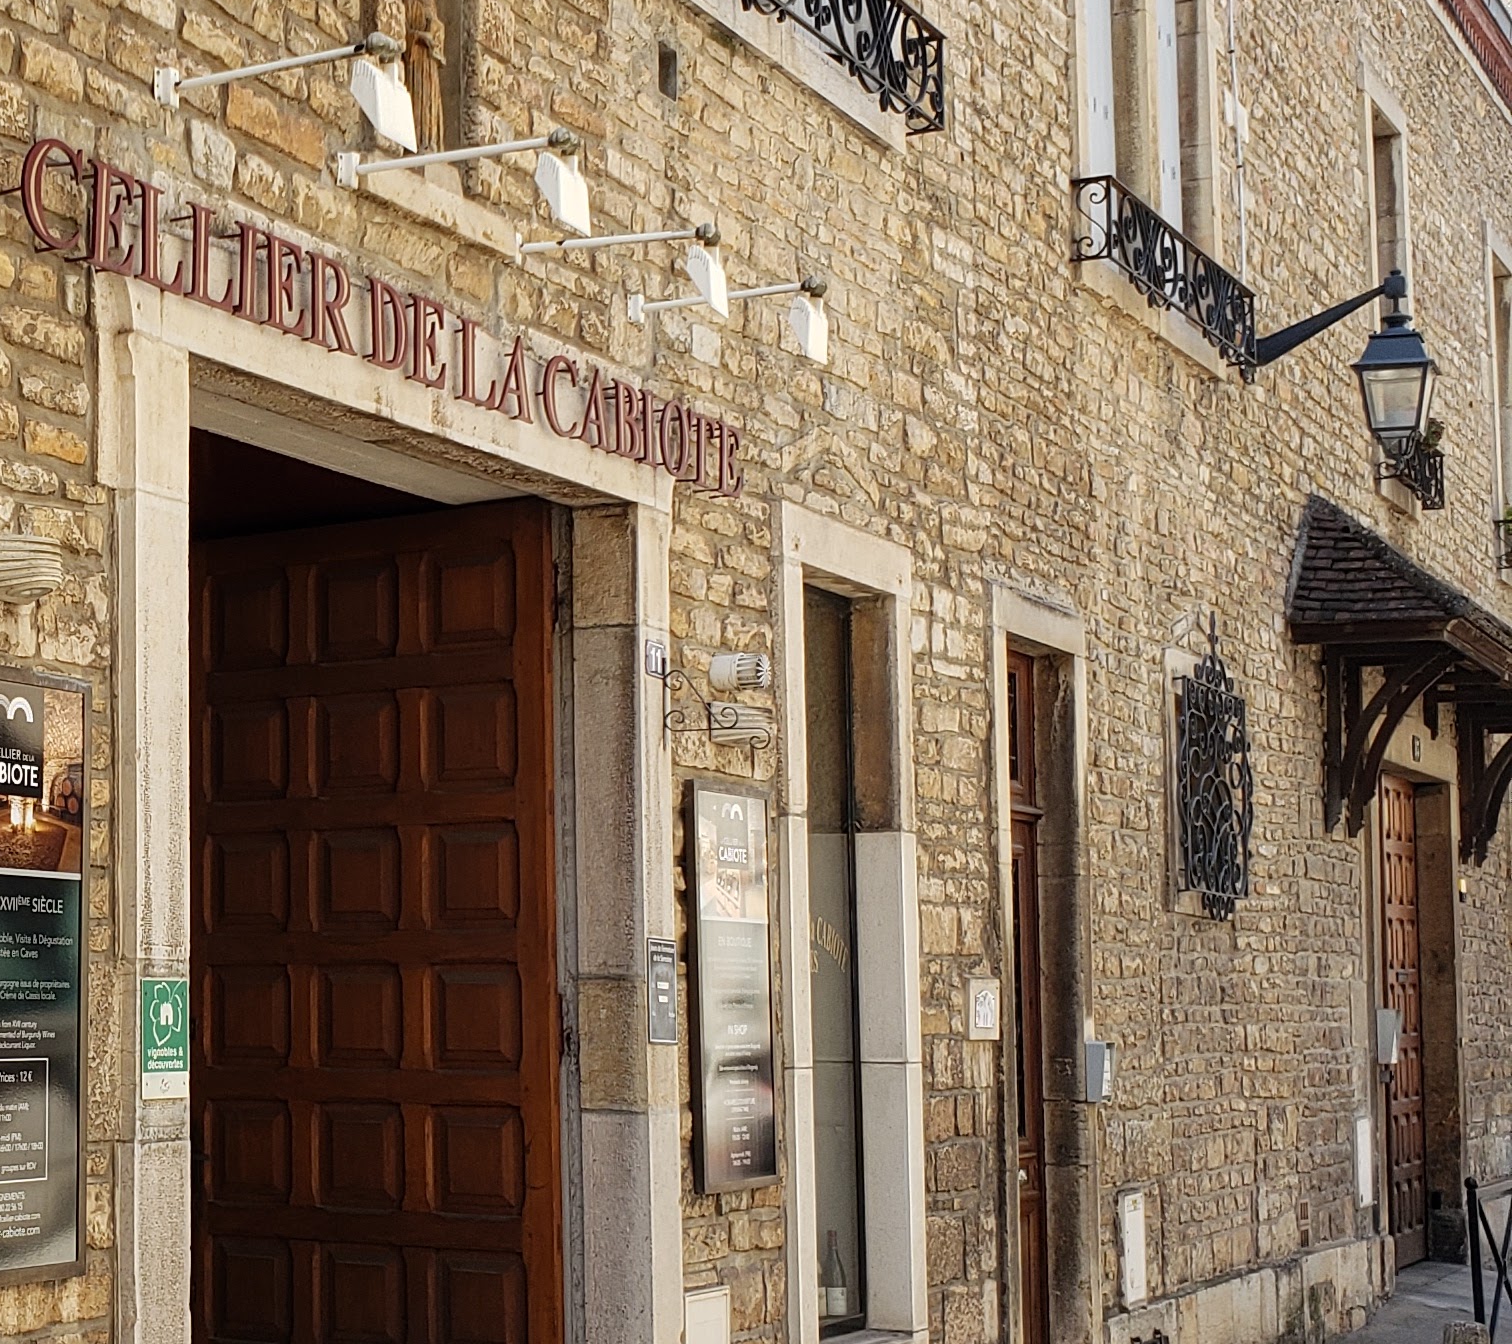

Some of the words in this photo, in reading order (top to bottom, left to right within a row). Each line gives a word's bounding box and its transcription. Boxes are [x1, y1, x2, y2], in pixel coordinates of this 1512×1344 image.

[21, 138, 357, 356] CELLIER
[366, 276, 446, 389] DE
[455, 316, 533, 423] LA
[541, 354, 743, 498] CABIOTE
[650, 647, 662, 675] 11
[718, 846, 748, 864] CABIOTE
[31, 895, 64, 914] SIÈCLE
[15, 933, 31, 945] Visite
[38, 934, 74, 948] Dégustation
[12, 949, 19, 957] en
[20, 947, 39, 959] Caves
[147, 1046, 177, 1060] vignobles
[179, 1046, 184, 1056] &
[147, 1059, 184, 1070] découvertes
